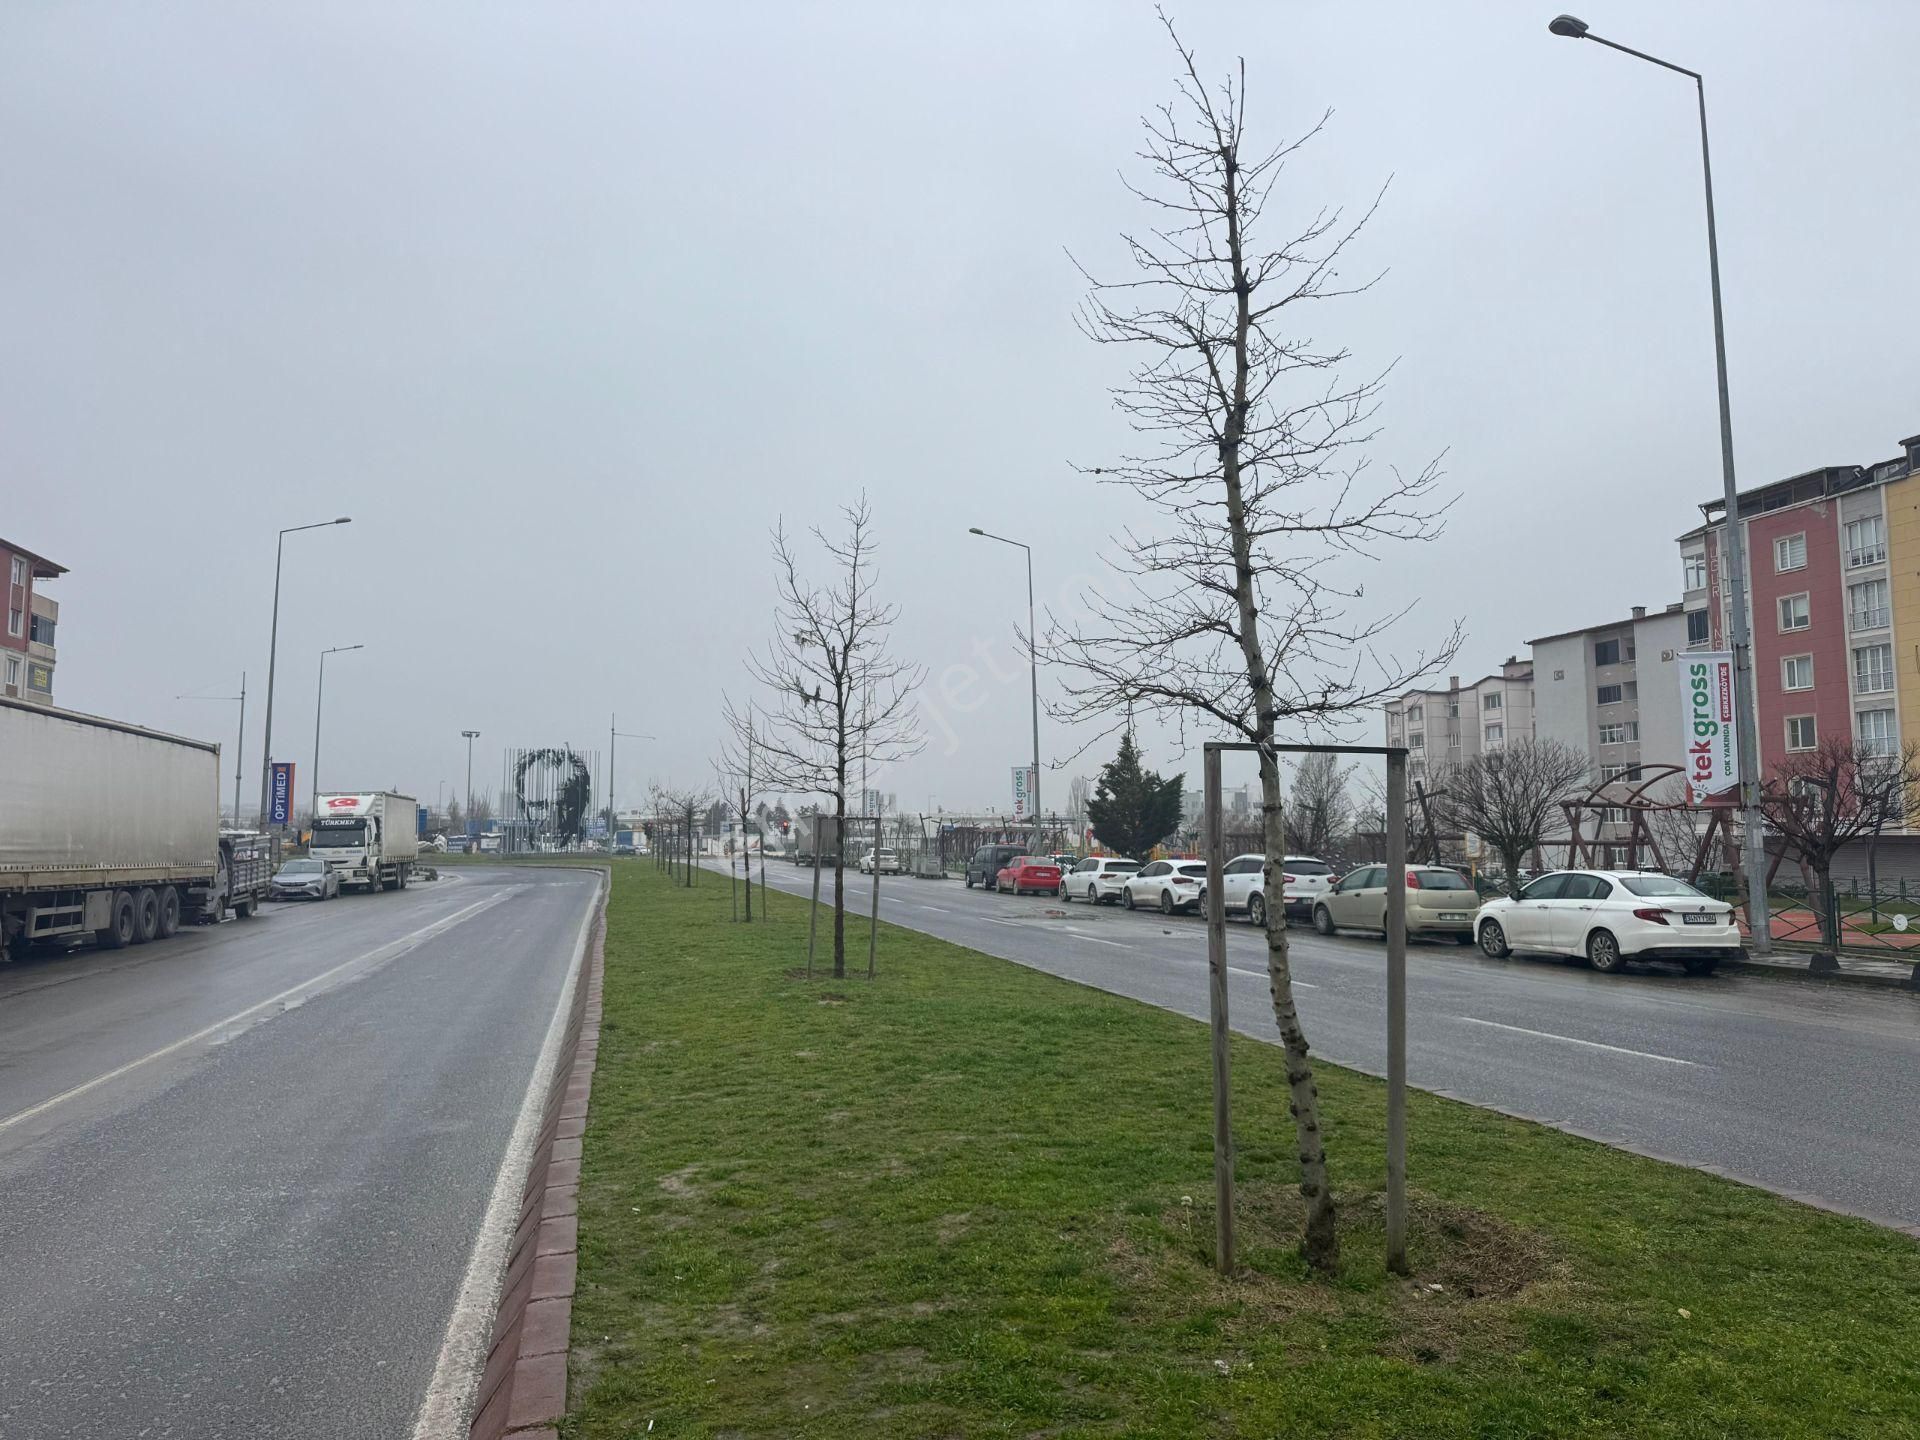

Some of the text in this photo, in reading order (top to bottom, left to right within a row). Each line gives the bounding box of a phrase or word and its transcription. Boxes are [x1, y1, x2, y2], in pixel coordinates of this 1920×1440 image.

[1689, 663, 1718, 783] tekgross
[1723, 724, 1731, 759] YAKINDA
[1723, 759, 1732, 776] ÇOK
